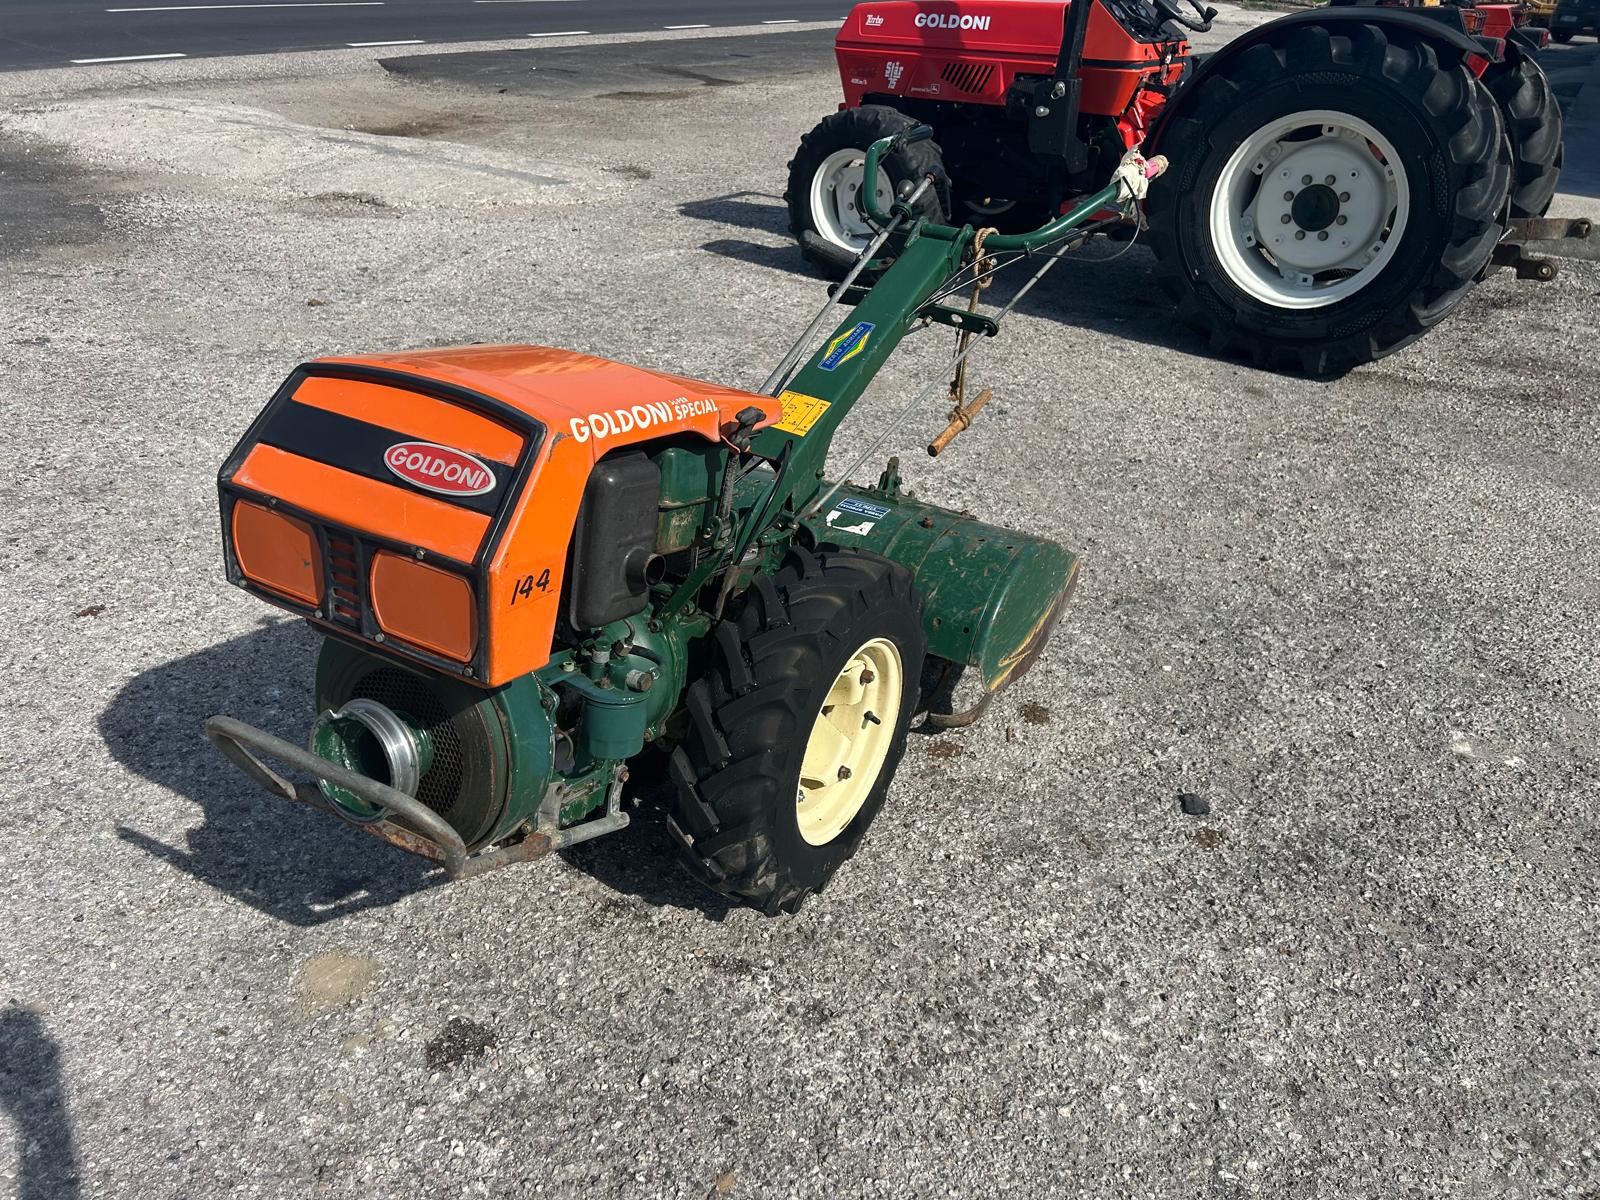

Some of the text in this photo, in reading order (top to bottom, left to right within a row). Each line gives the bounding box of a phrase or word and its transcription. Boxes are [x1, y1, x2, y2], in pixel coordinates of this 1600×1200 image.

[914, 13, 991, 31] GOLDONI
[569, 401, 673, 443] GOLDONI
[674, 398, 718, 421] SPECIAL
[390, 447, 486, 489] GOLDONI
[510, 568, 551, 606] 144
